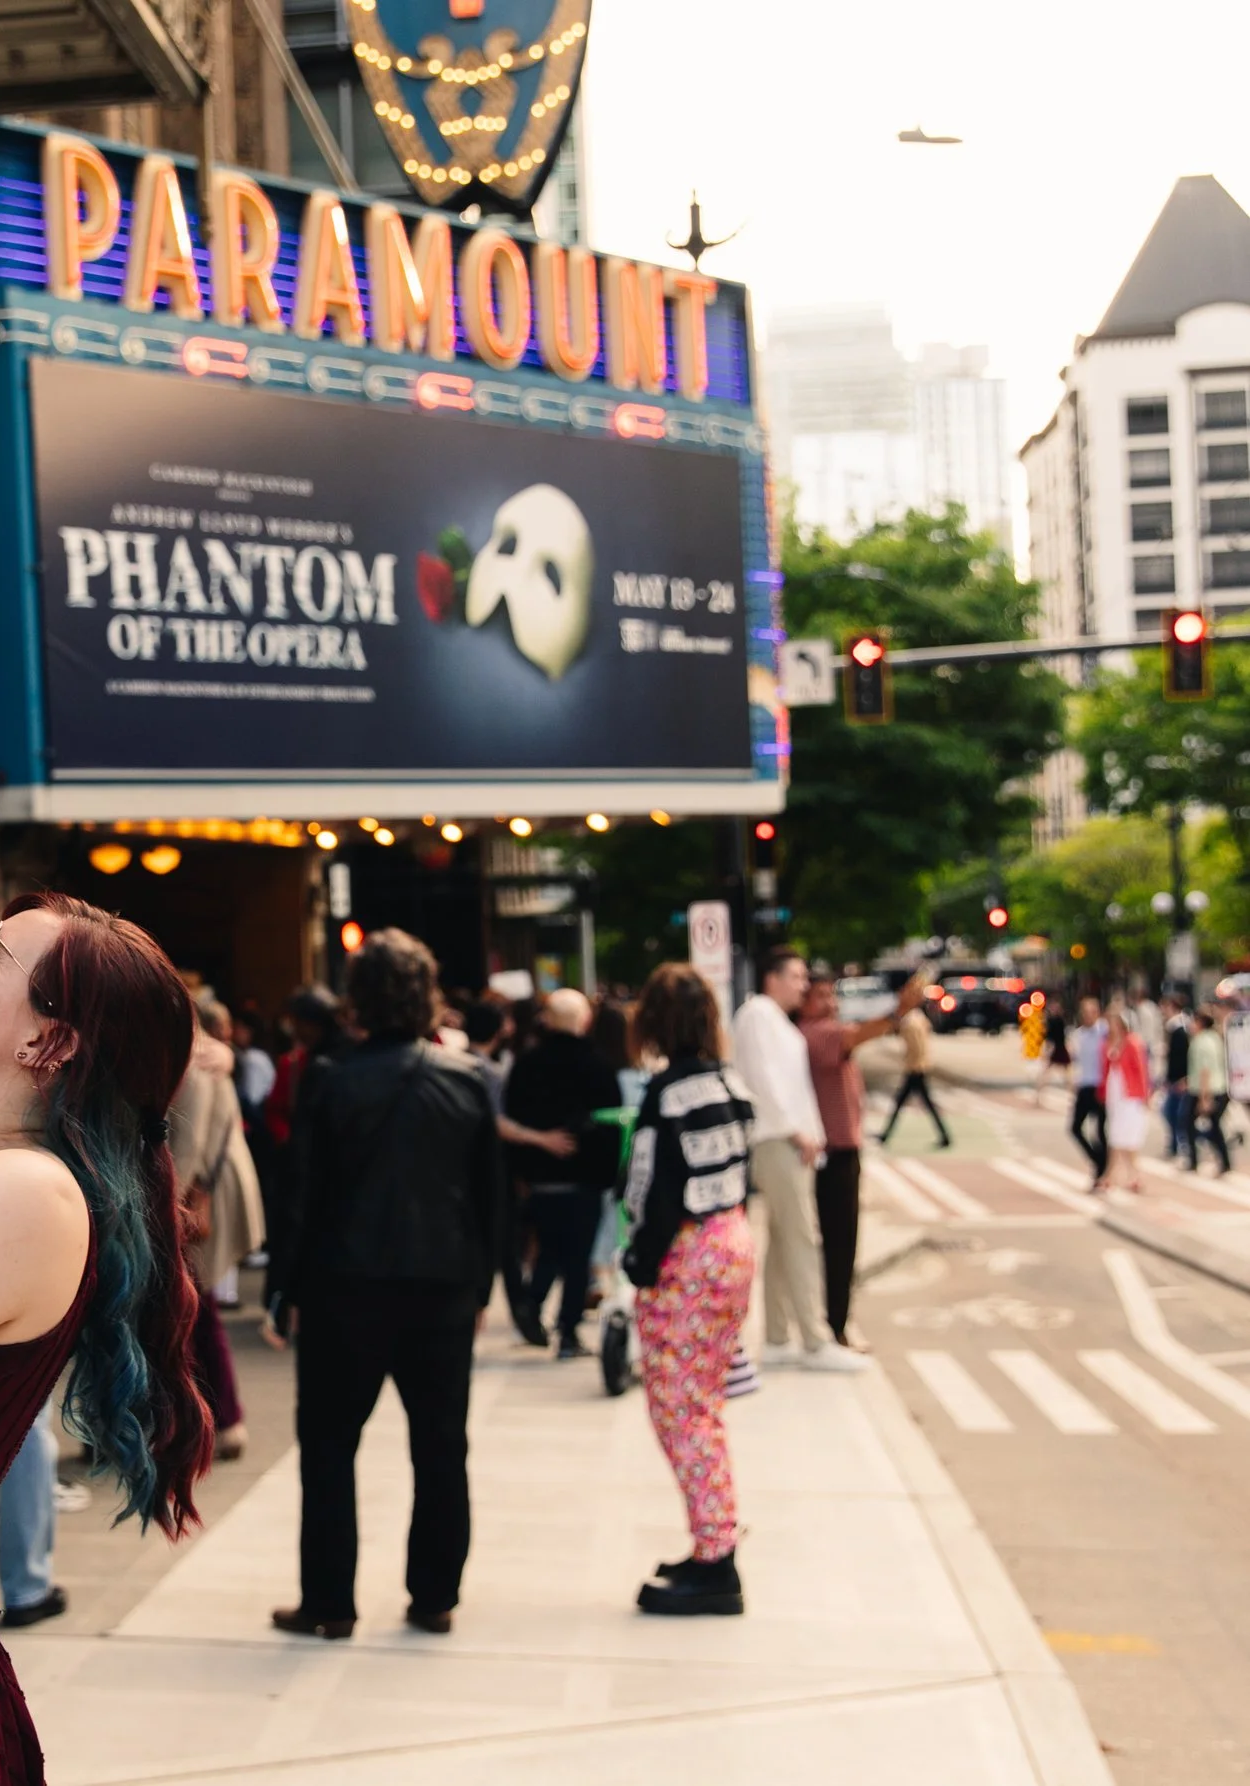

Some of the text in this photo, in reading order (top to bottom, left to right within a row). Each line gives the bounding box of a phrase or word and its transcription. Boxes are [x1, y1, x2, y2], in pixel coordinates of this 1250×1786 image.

[46, 131, 718, 401] PARAMOUNT
[110, 502, 195, 529] ANDREW
[58, 525, 399, 625] PHANTOM
[612, 570, 668, 610] MAY
[106, 613, 369, 672] OF THE OPERA
